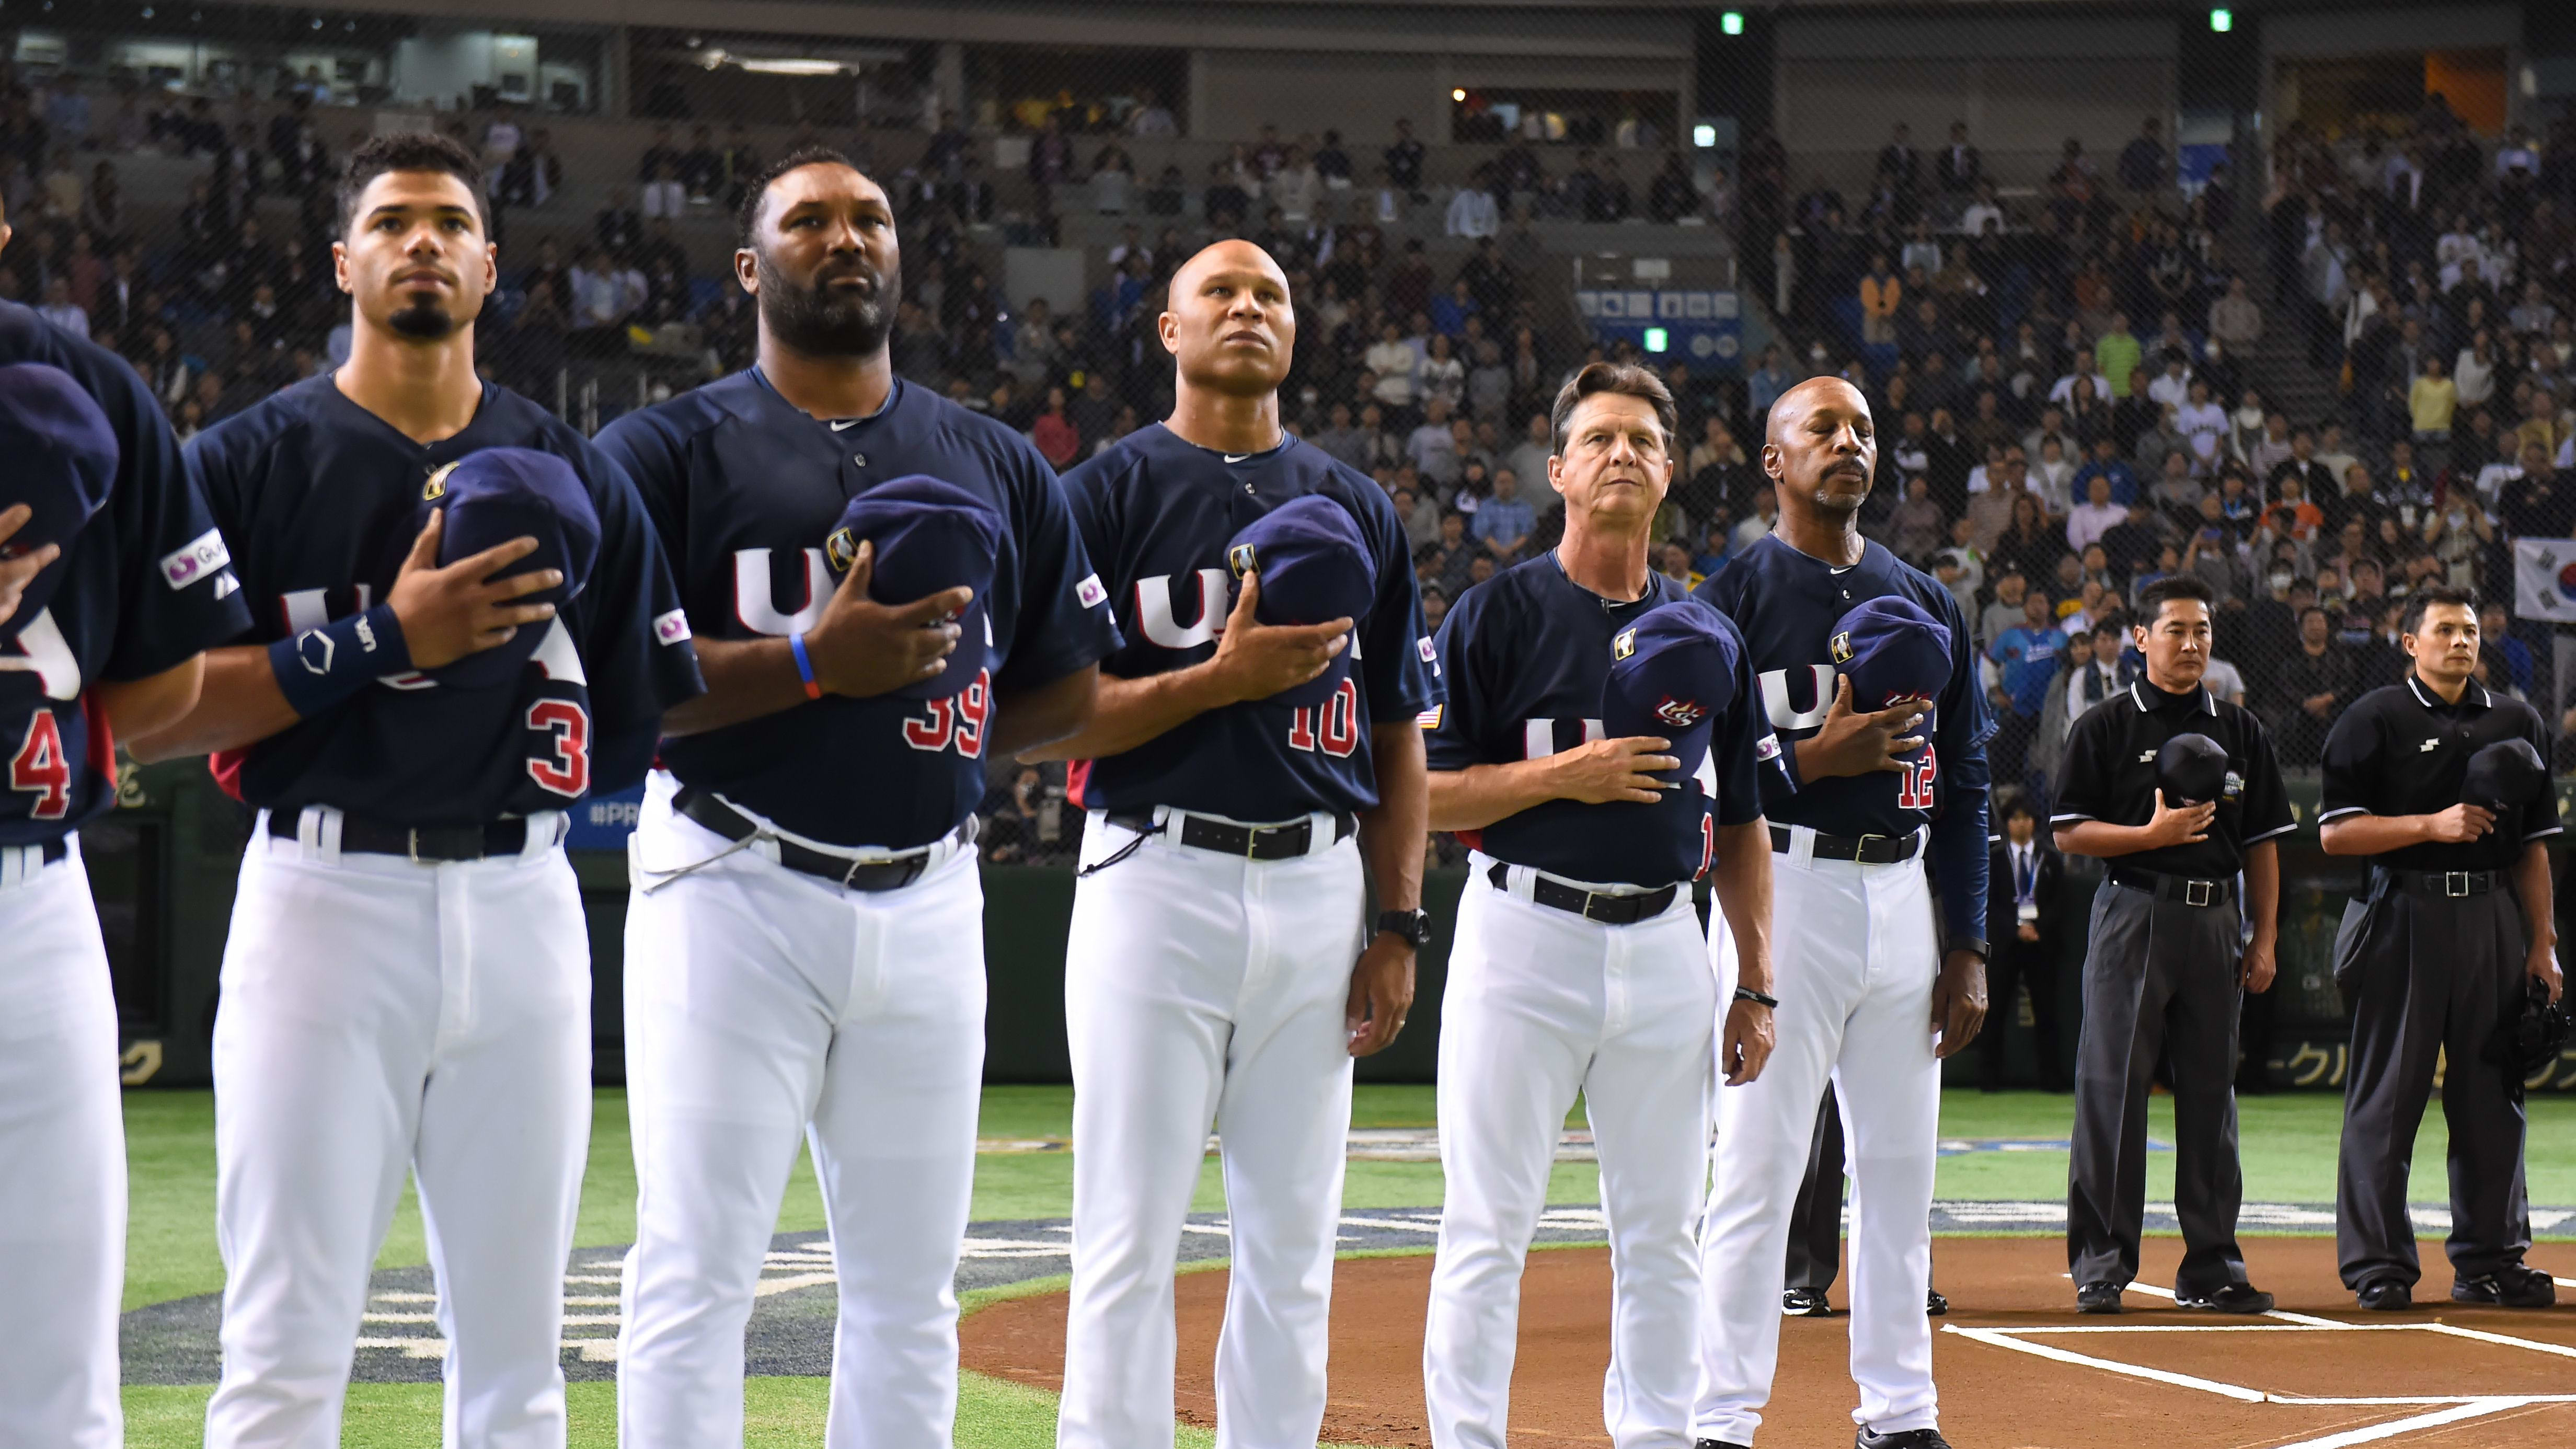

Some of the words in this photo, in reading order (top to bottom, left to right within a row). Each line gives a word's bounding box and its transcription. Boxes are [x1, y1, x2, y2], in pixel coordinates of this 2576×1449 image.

[526, 698, 590, 798] 3
[902, 666, 990, 760] 39
[1289, 676, 1358, 758] 10
[10, 708, 71, 820] 4
[1898, 742, 1937, 810] 12
[589, 801, 641, 827] #PR
